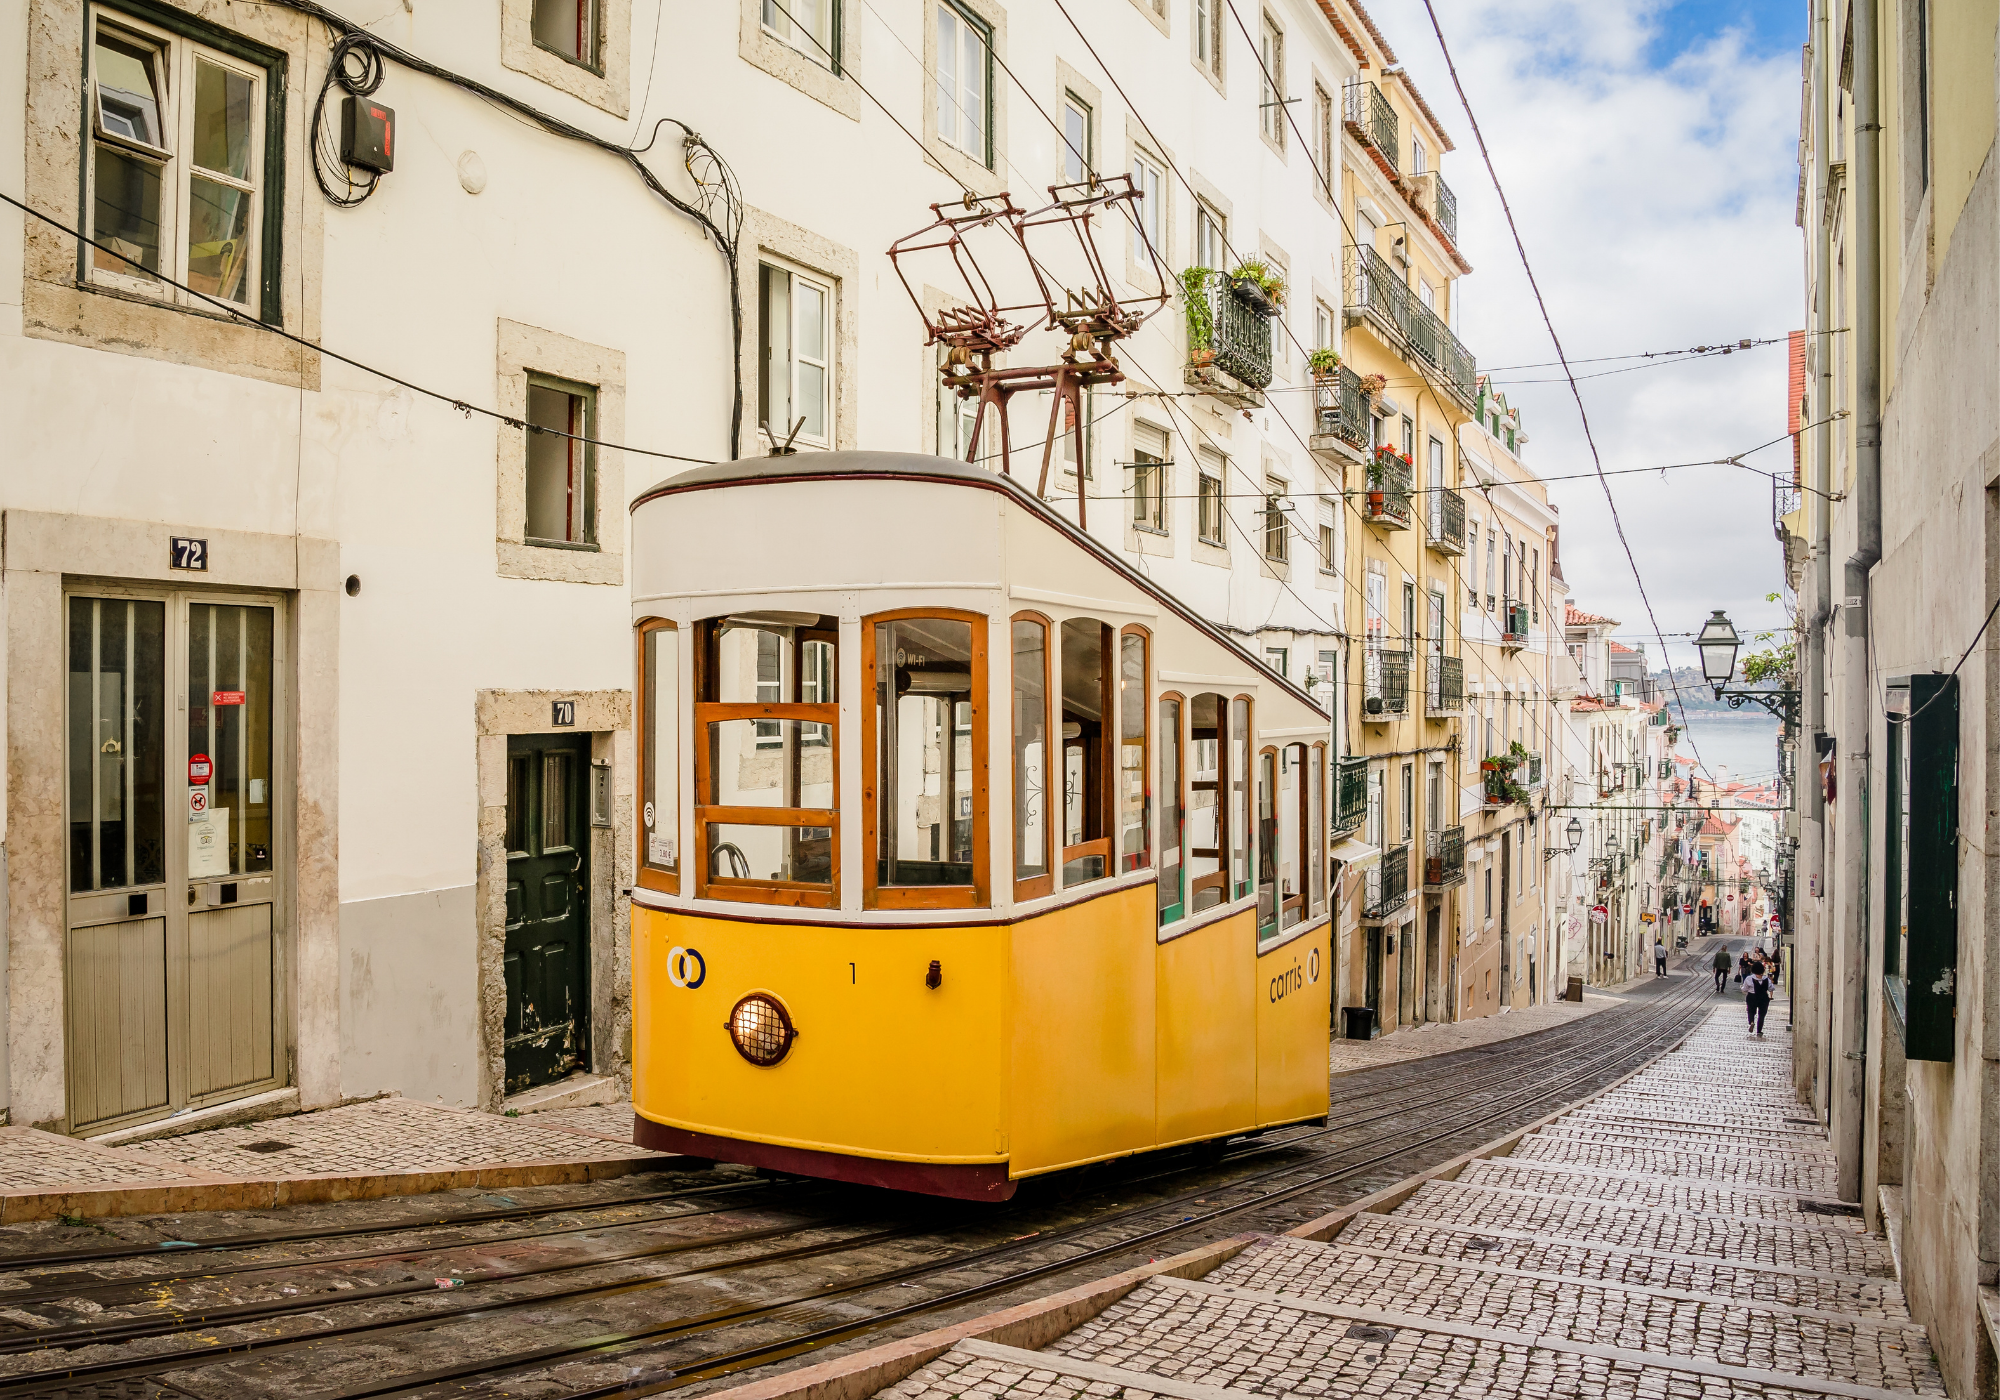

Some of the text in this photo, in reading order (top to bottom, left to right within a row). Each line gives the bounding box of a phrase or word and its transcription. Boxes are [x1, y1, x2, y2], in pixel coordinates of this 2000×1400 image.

[177, 539, 202, 569] 72
[907, 653, 926, 667] WI-FI
[557, 703, 572, 724] 70
[848, 962, 856, 985] 1
[1269, 956, 1302, 1004] carris
